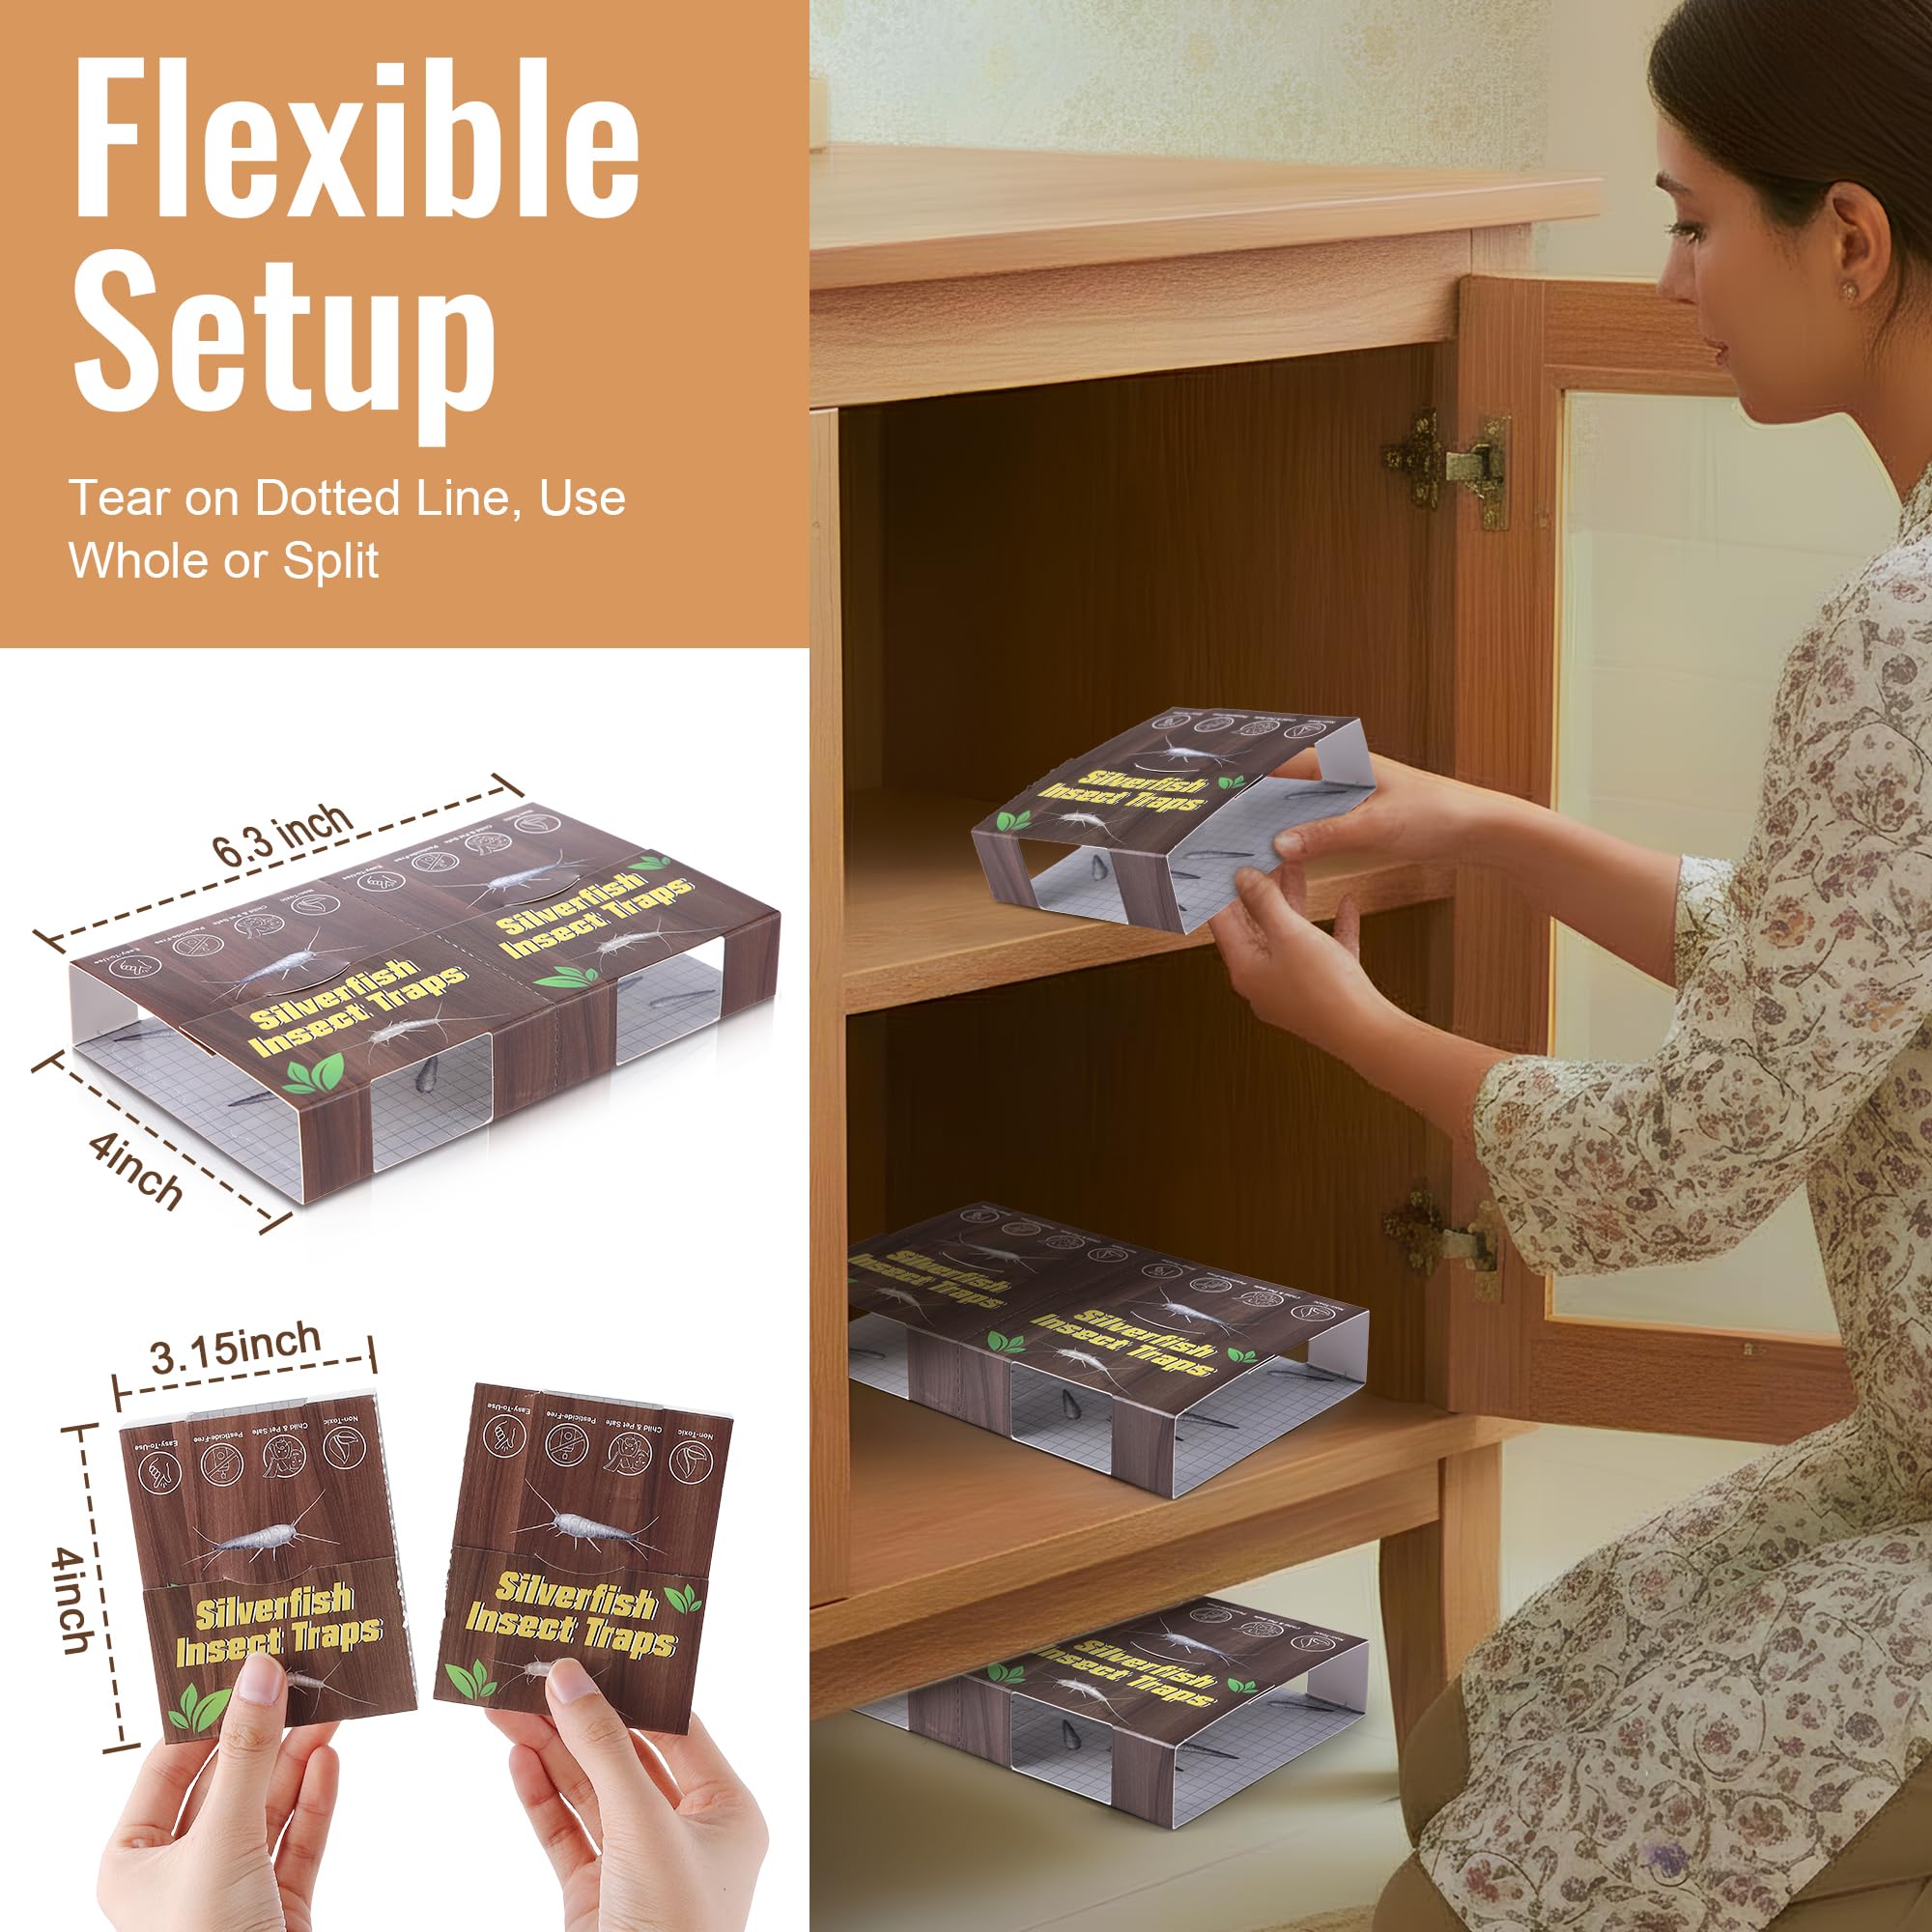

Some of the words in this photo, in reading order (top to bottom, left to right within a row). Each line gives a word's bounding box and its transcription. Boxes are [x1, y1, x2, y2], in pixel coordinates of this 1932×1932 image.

[1037, 782, 1131, 805] Insect
[1123, 792, 1208, 812] Traps
[1078, 770, 1208, 793] Silverfish
[496, 872, 648, 935] Silverfish
[498, 912, 611, 959] Insect
[601, 878, 696, 919] Traps
[249, 959, 421, 1030] Silverfish
[247, 1004, 374, 1059] Insect
[366, 966, 469, 1012] Traps
[886, 1250, 1011, 1293] Silverfish
[927, 1280, 1008, 1310] Traps
[1030, 1313, 1133, 1351] Insect
[1127, 1344, 1217, 1378] Traps
[1074, 1309, 1217, 1359] Silverfish
[323, 1415, 358, 1426] Non-Toxic
[487, 1403, 531, 1415] Easy-To-Use
[546, 1410, 597, 1424] Pesticide-Free
[606, 1419, 622, 1428] Safe
[193, 1431, 243, 1443] Pesticide-Free
[290, 1422, 308, 1431] Child
[623, 1421, 635, 1430] Pet
[643, 1425, 663, 1434] Child
[677, 1429, 714, 1440] Non-Toxic
[134, 1439, 178, 1451] Easy-To-Use
[196, 1581, 355, 1631] Silverfish
[495, 1570, 659, 1620] Silverfish
[177, 1627, 284, 1668] Insect
[292, 1618, 384, 1653] Traps
[466, 1601, 579, 1643] Insect
[584, 1617, 679, 1661] Traps
[1074, 1639, 1217, 1689] Silverfish
[1127, 1674, 1217, 1708] Traps
